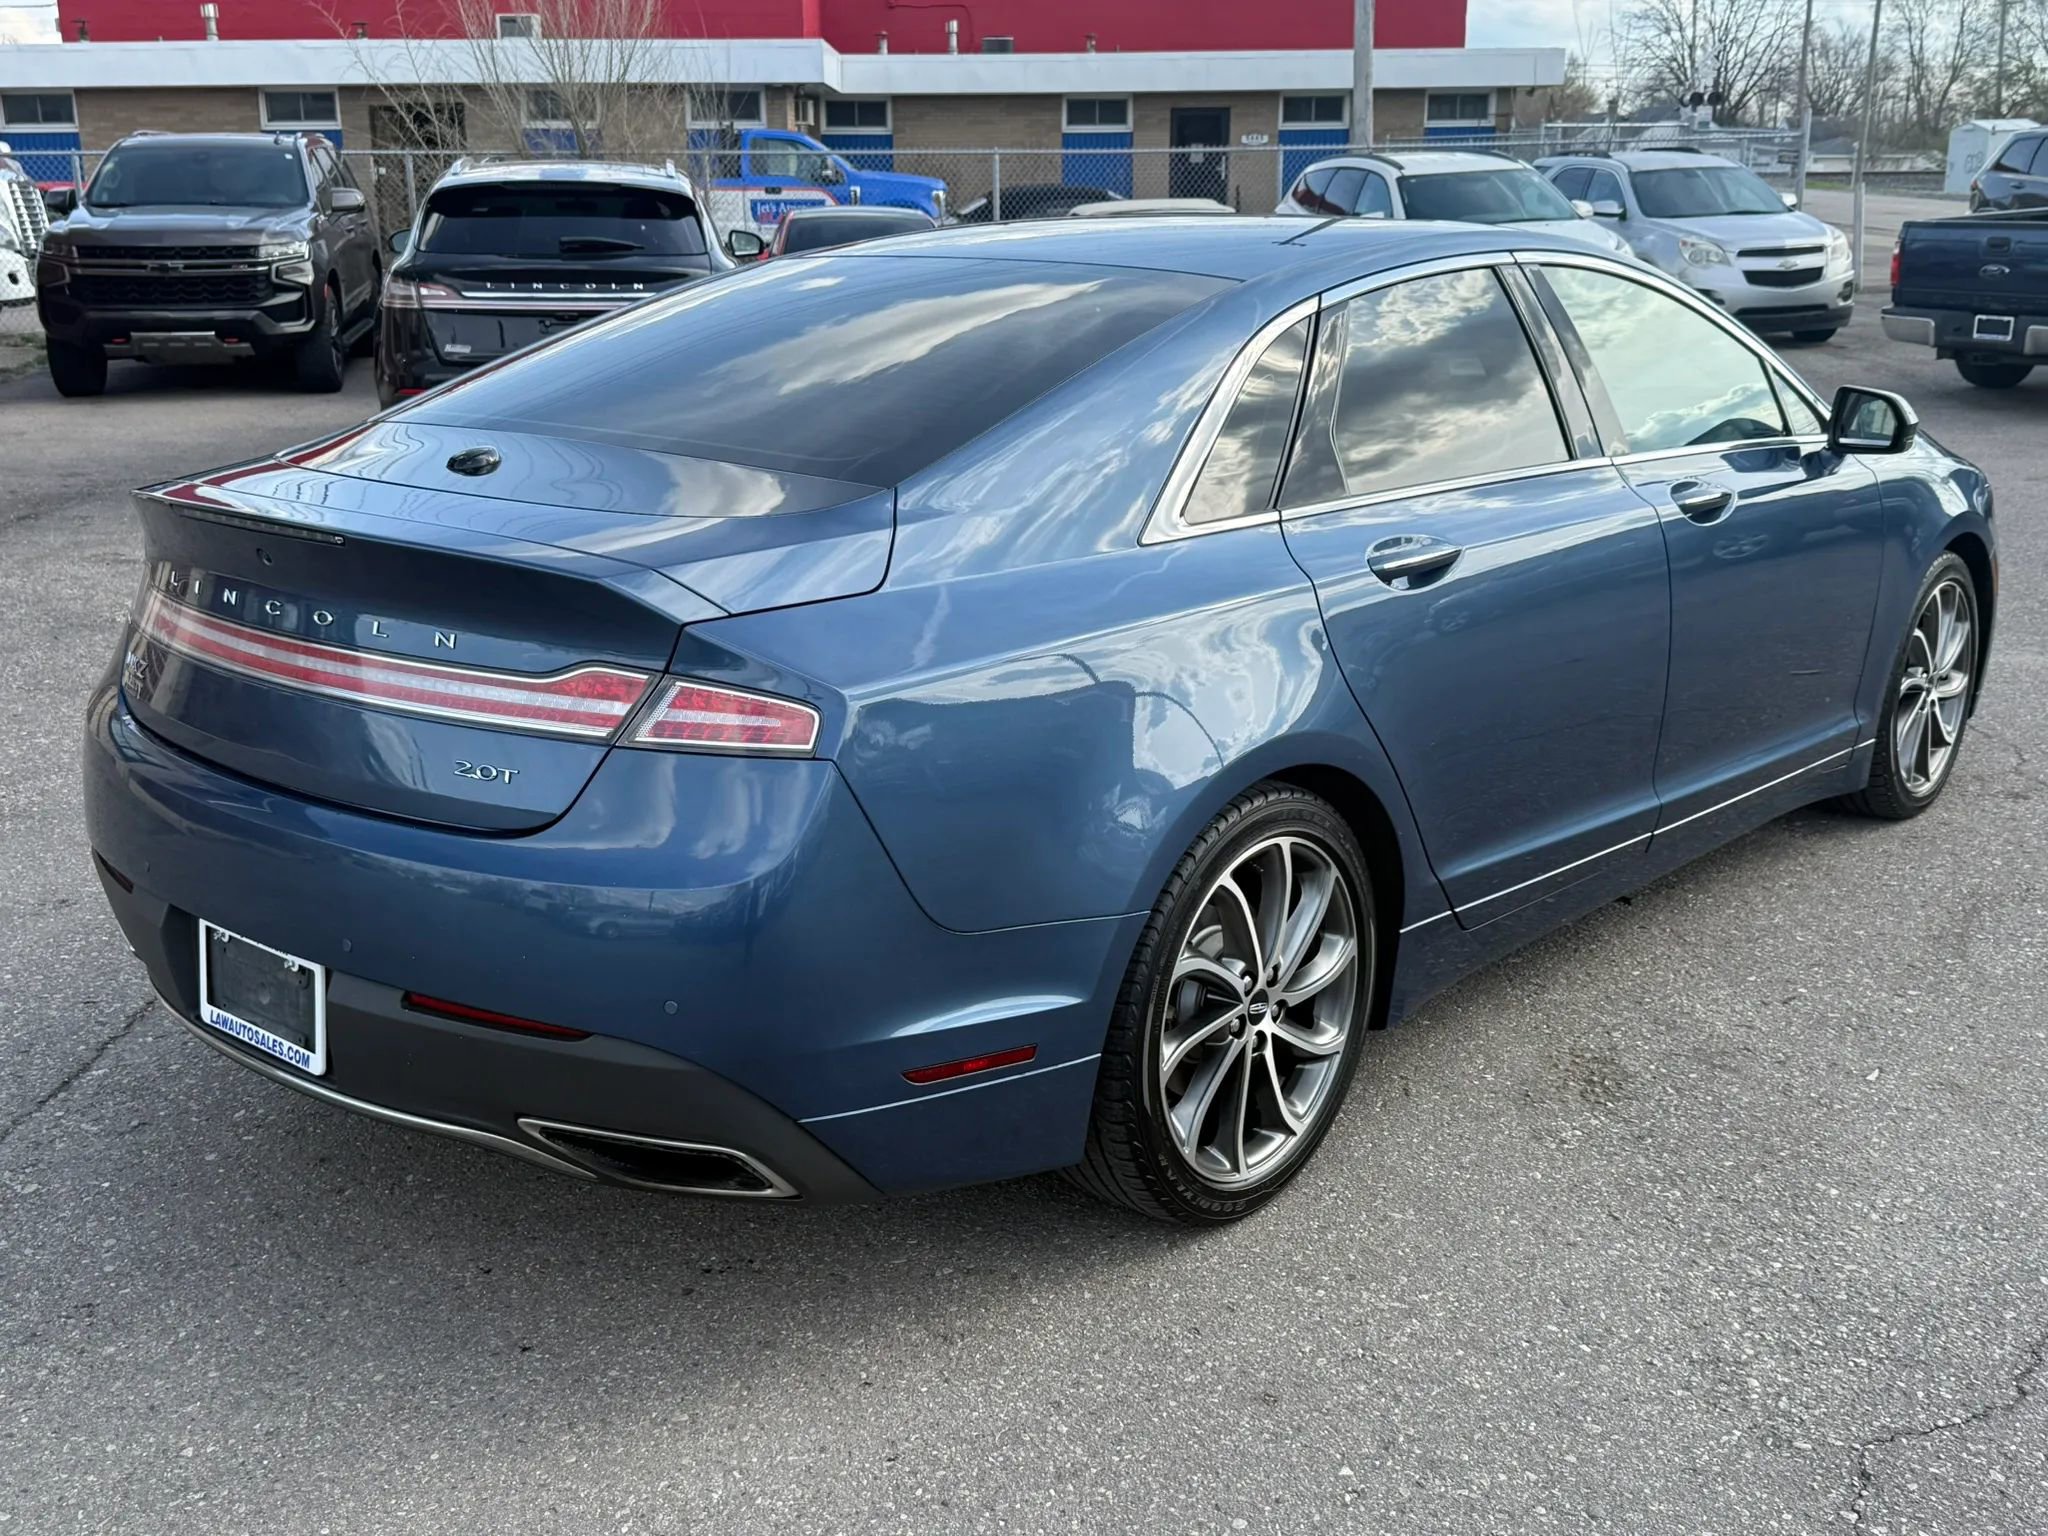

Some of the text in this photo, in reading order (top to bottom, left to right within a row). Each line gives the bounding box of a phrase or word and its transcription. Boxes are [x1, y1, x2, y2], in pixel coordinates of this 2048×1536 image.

[486, 282, 644, 290] LINCOLN
[170, 571, 457, 650] LINCOLN
[210, 1009, 311, 1069] LAWAUTOSALES.COM
